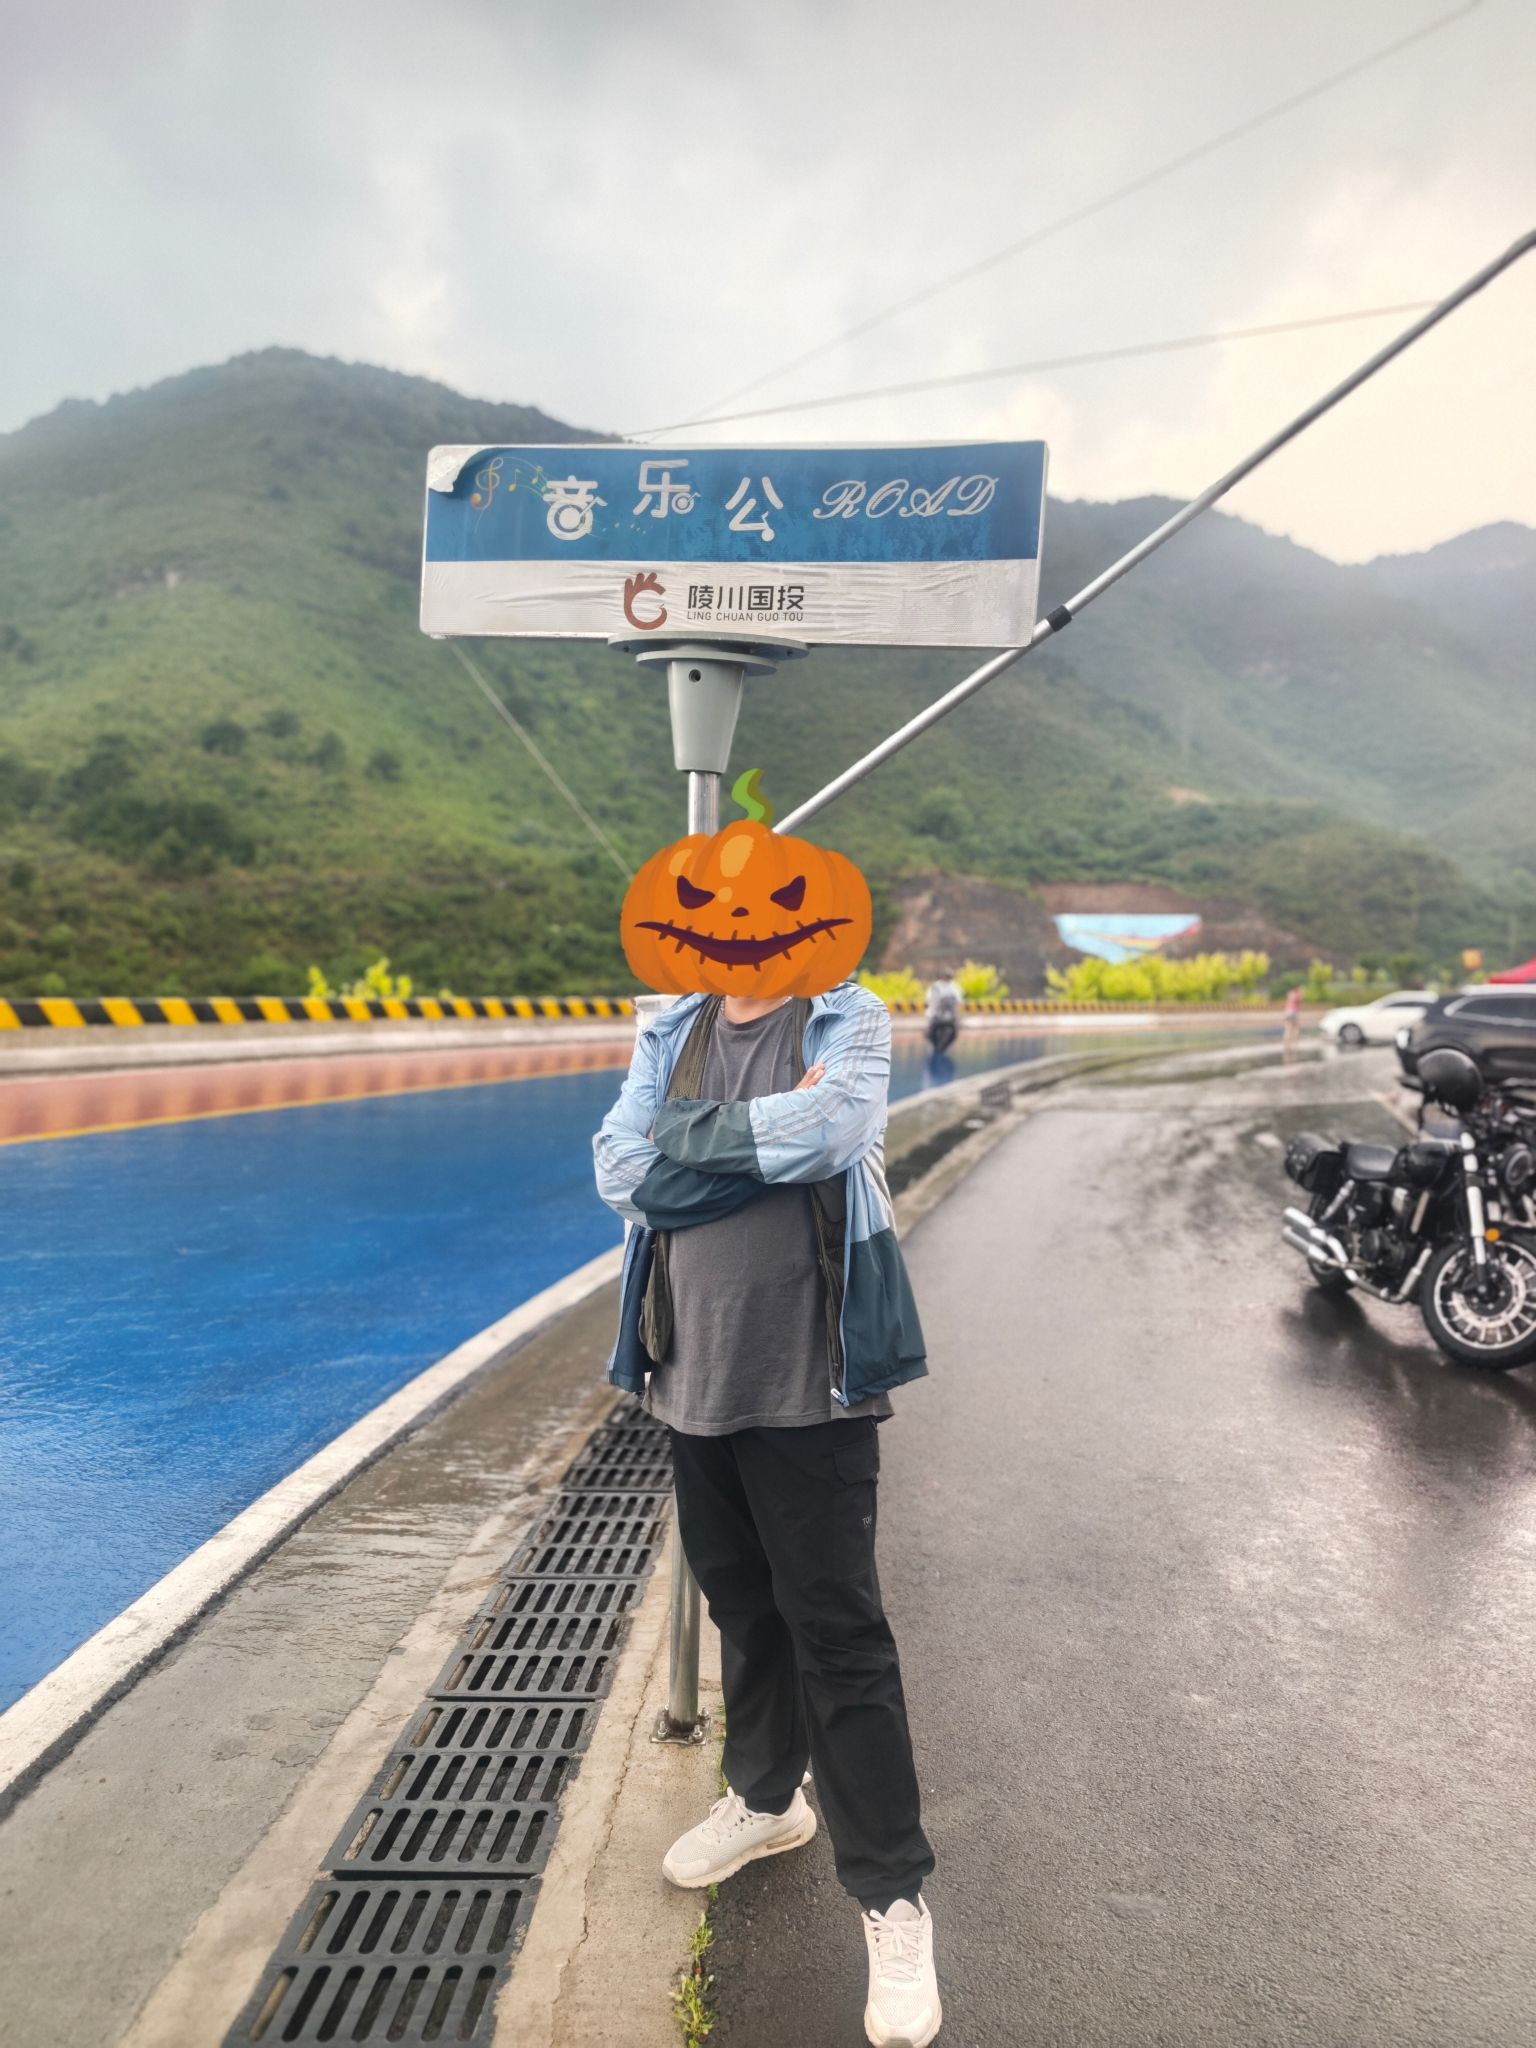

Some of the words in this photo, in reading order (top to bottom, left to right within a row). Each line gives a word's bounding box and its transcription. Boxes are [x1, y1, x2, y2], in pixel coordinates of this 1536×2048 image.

[812, 474, 999, 519] ROAD
[687, 585, 805, 610] 陵川国投
[687, 611, 712, 621] LING
[716, 612, 753, 621] CHUAN
[757, 612, 779, 622] GUO
[783, 612, 804, 622] TOU
